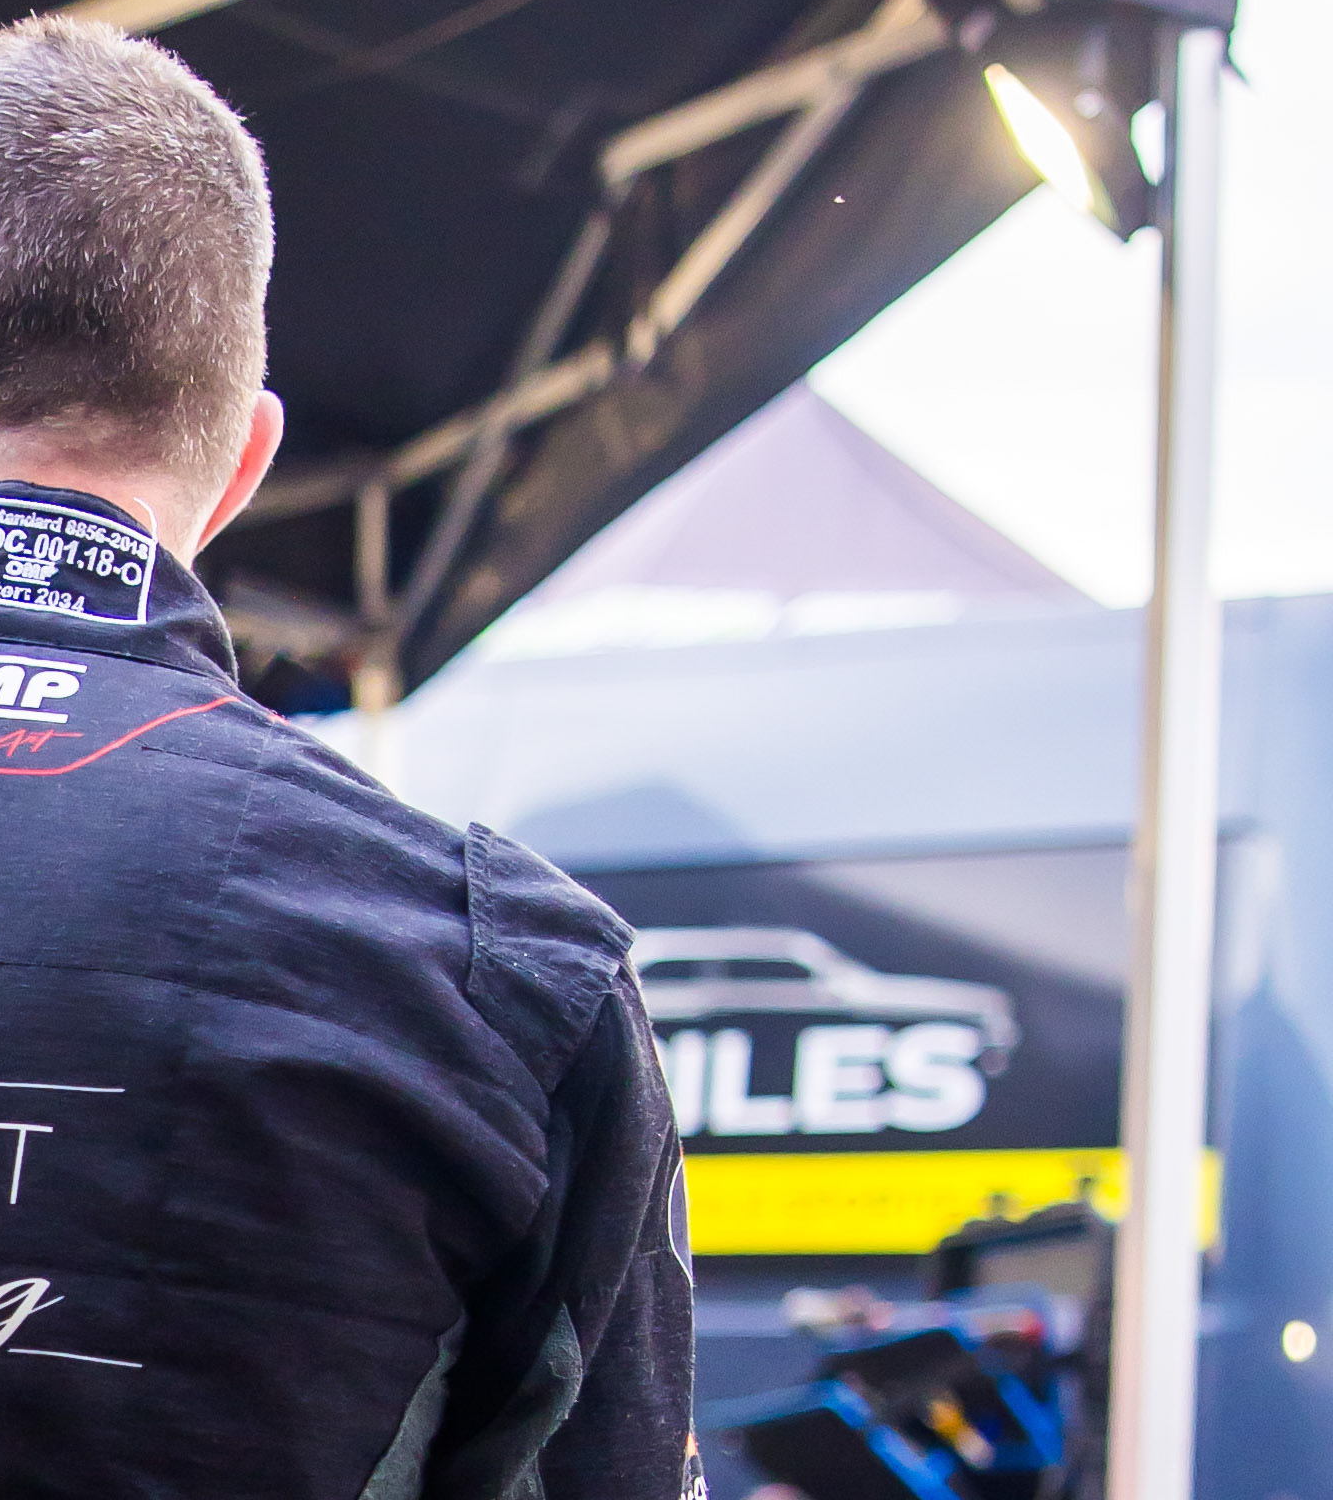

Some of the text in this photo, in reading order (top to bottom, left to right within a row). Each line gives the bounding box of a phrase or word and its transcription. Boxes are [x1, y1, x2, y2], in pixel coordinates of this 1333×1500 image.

[64, 519, 149, 560] 8856-2018
[4, 560, 59, 581] OMP
[34, 587, 85, 613] 2034
[653, 1021, 986, 1137] ILES
